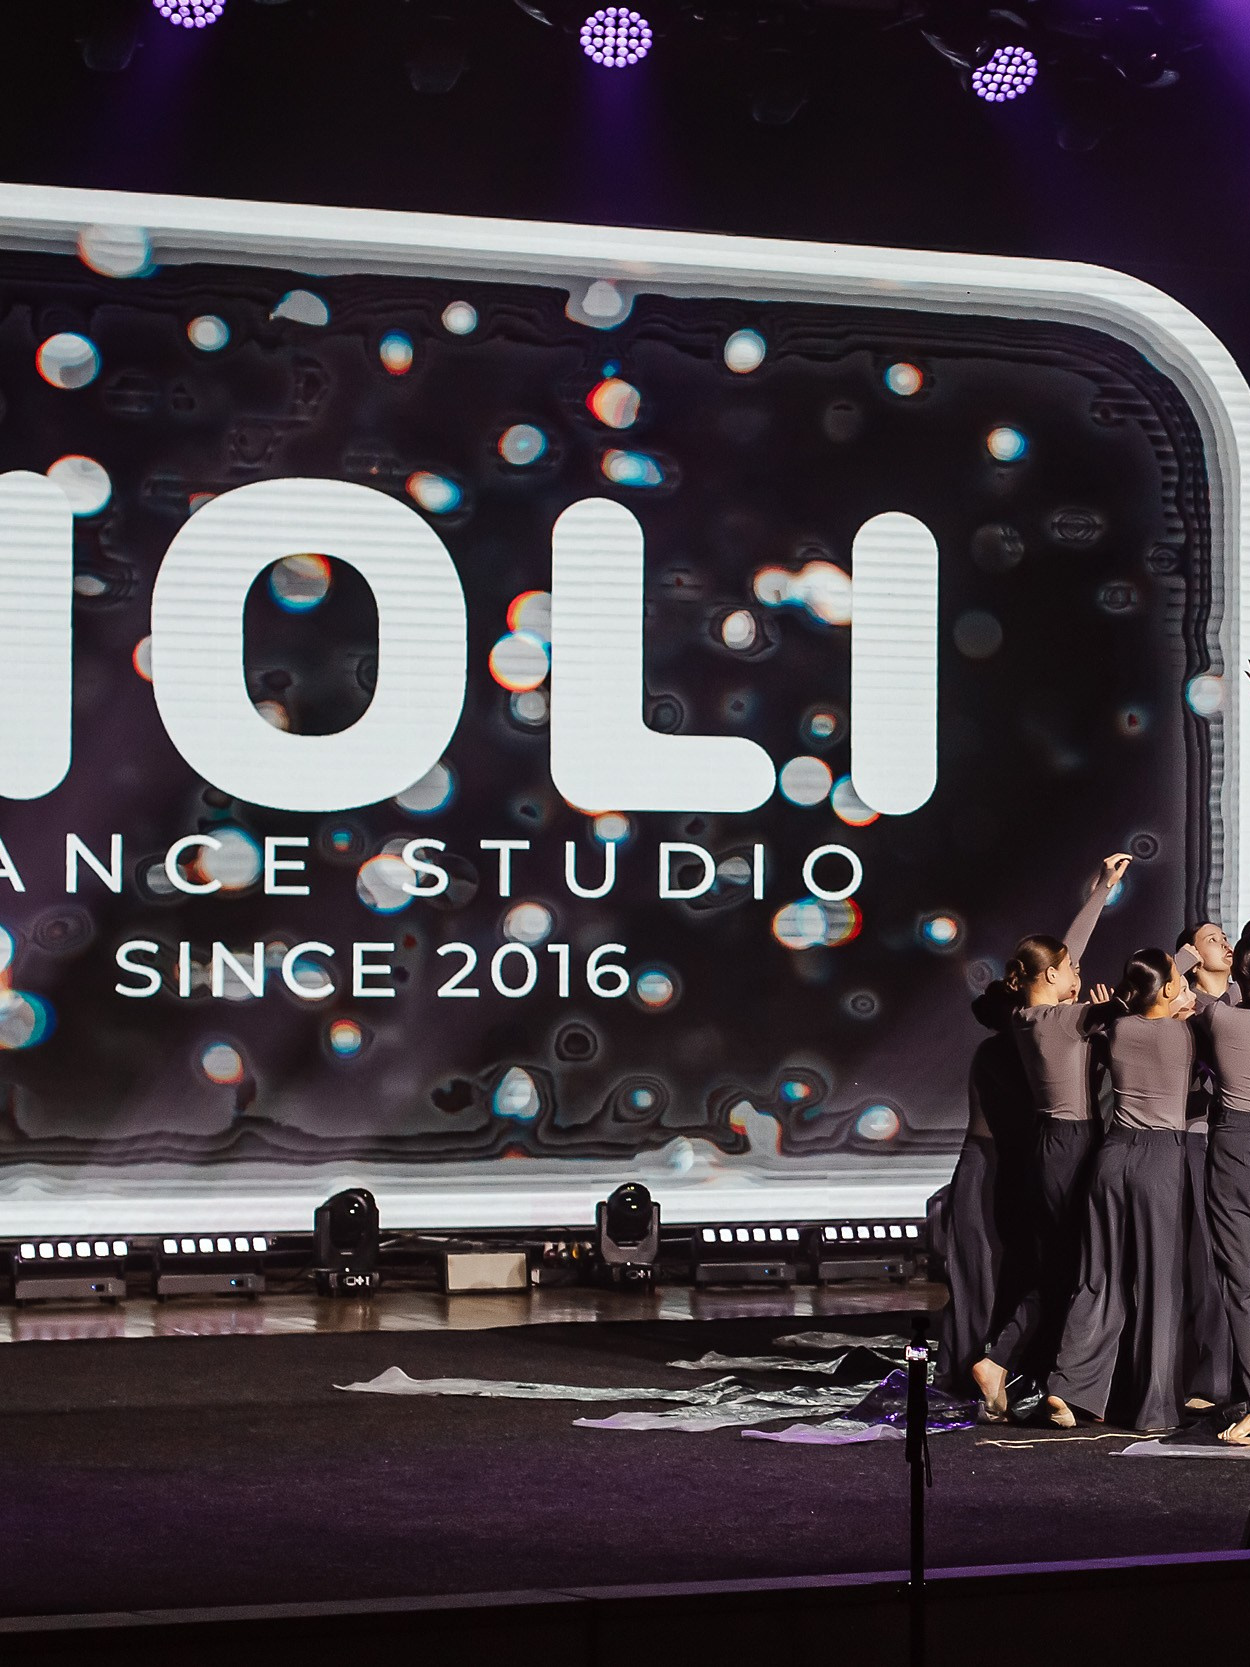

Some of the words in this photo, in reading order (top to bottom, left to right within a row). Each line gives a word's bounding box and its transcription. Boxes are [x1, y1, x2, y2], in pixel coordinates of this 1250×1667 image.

[398, 837, 864, 901] STUDIO
[114, 939, 396, 998] SINCE
[436, 942, 630, 998] 2016
